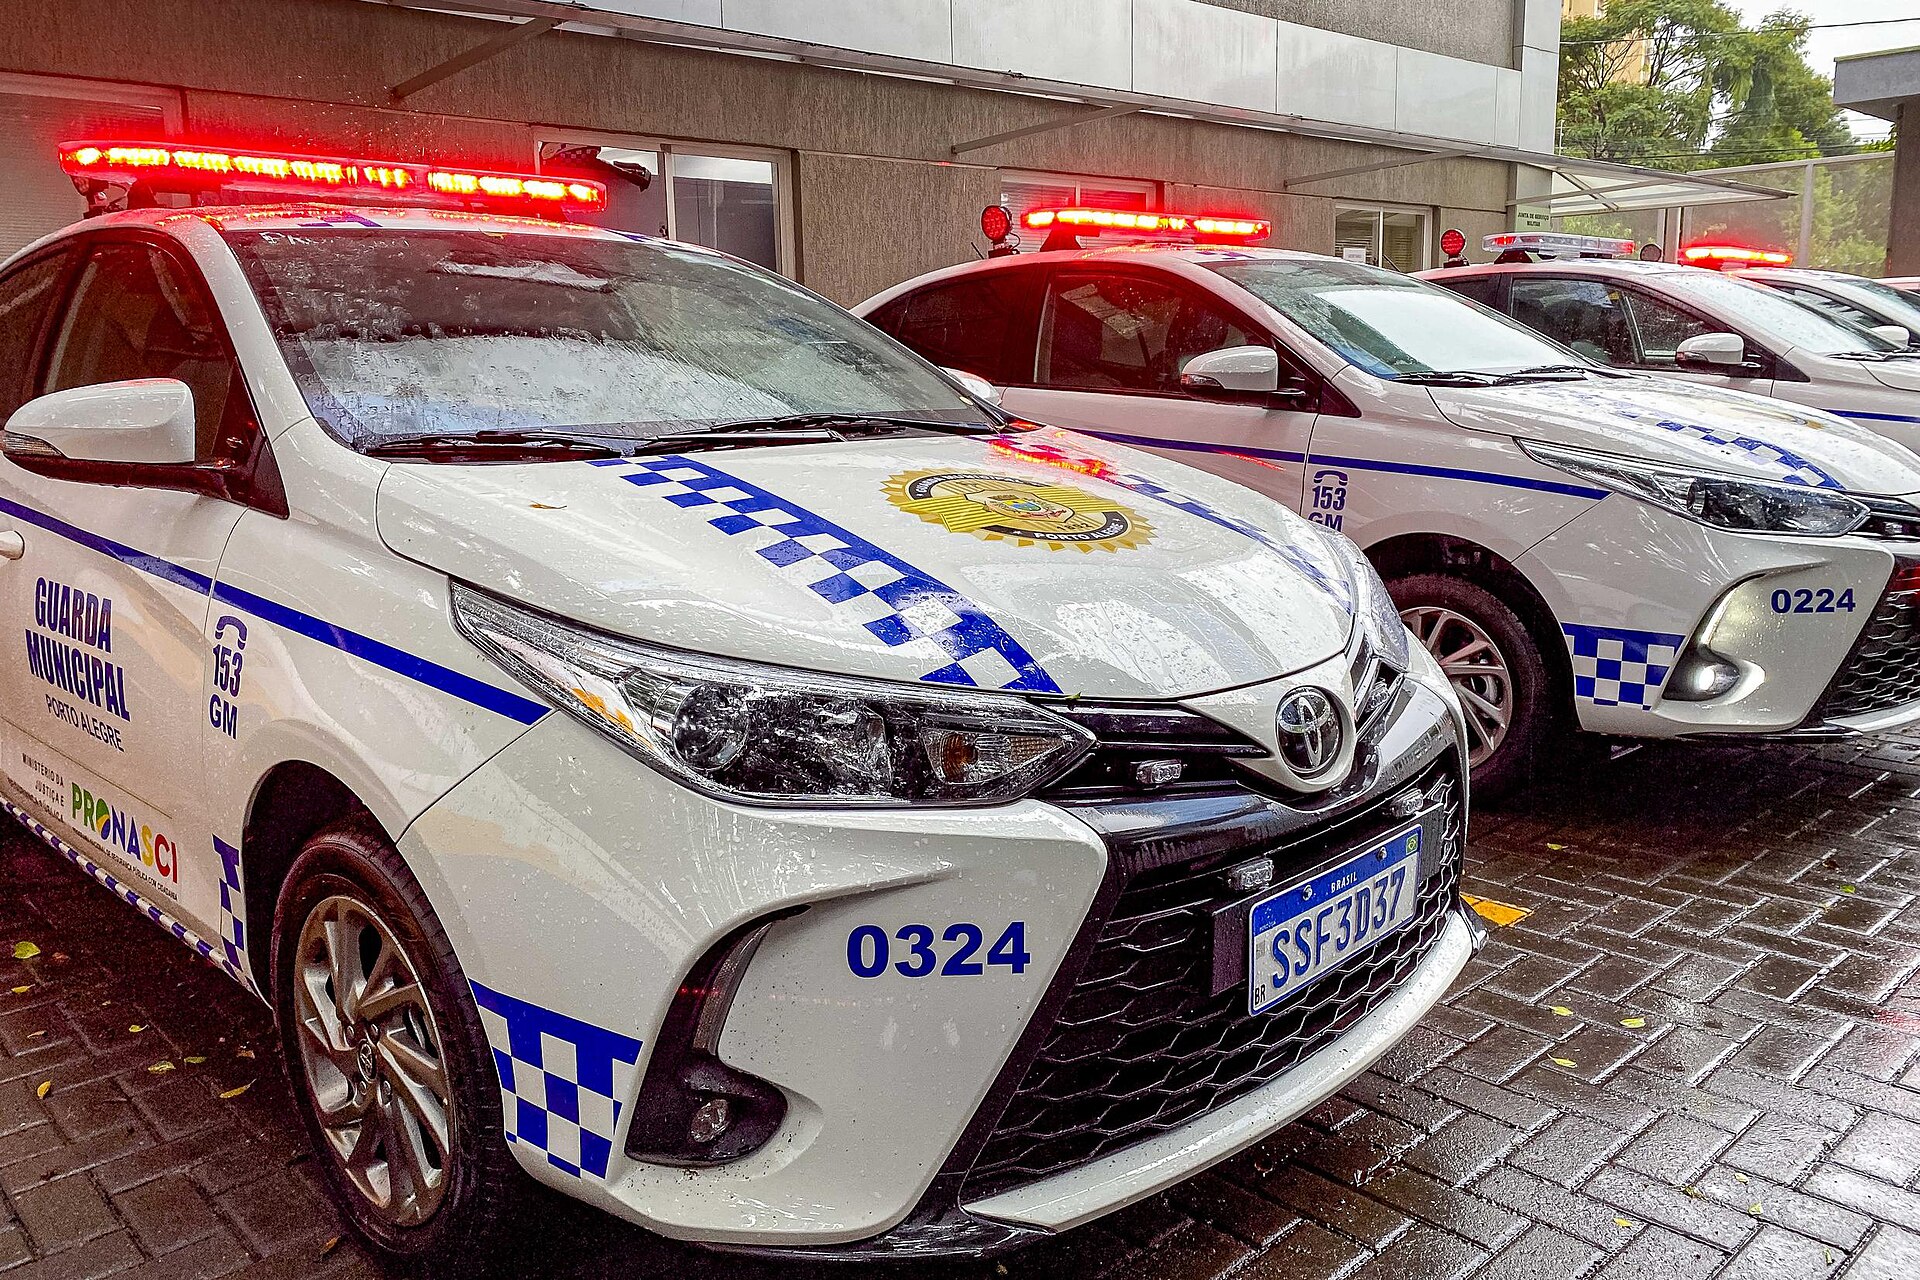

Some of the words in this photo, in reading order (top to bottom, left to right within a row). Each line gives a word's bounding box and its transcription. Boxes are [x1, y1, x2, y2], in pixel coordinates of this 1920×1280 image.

[1312, 485, 1347, 511] 153
[1033, 531, 1091, 540] PORTO
[1090, 522, 1124, 540] ALEGRE
[35, 577, 112, 653] GUARDA
[1771, 587, 1856, 614] 0224
[25, 628, 131, 722] MUNICIPAL
[213, 643, 243, 698] 153
[45, 694, 79, 728] PORTO
[81, 711, 124, 752] ALEGRE
[209, 695, 239, 740] GM
[22, 752, 55, 782] MINISTÉRIO
[56, 773, 64, 788] DA
[35, 780, 59, 804] JUSTIÇA
[60, 795, 65, 807] E
[71, 782, 178, 884] PRONASCI
[1330, 872, 1358, 894] BRASIL
[1272, 865, 1406, 989] SSF3D37
[846, 921, 1031, 979] 0324
[1254, 984, 1266, 1006] BR
